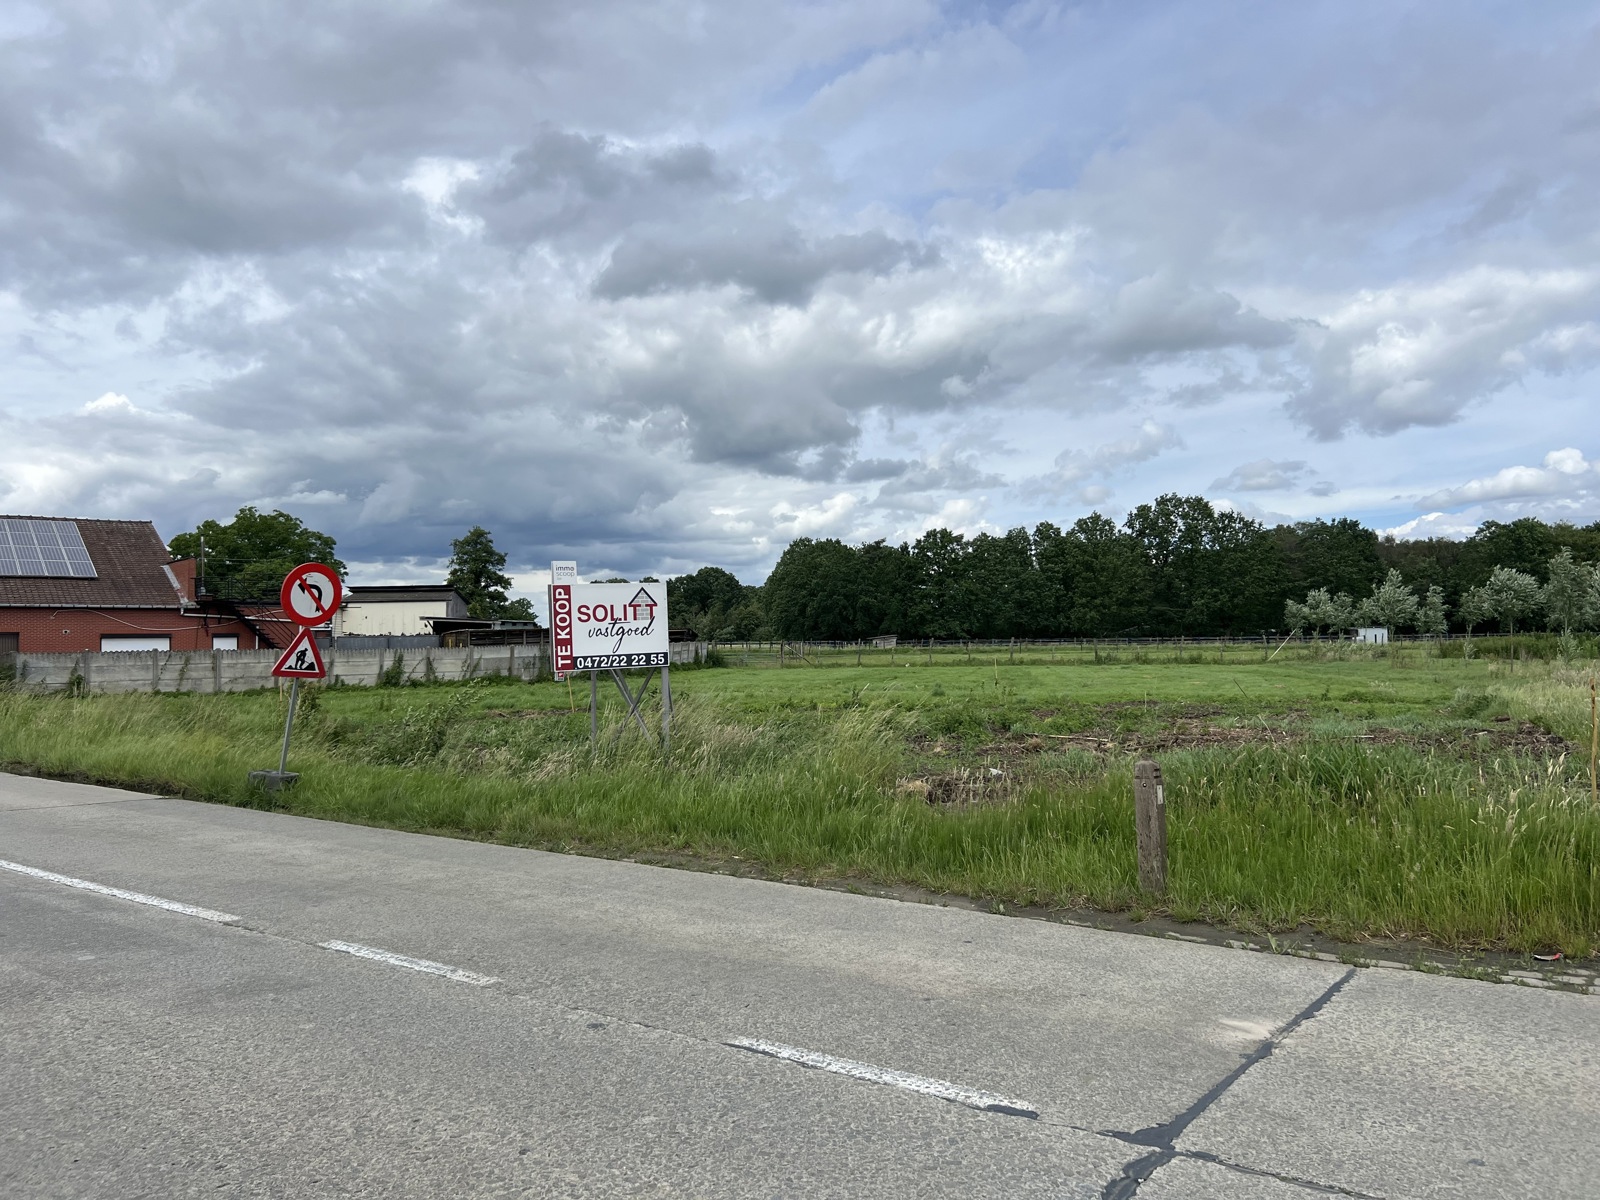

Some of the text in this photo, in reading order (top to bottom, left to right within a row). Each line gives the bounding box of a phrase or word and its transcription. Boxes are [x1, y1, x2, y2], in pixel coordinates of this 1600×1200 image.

[555, 588, 570, 639] KOOP
[588, 616, 656, 654] vastgoed
[557, 645, 571, 667] TE
[576, 653, 665, 669] 0472/22 22 55
